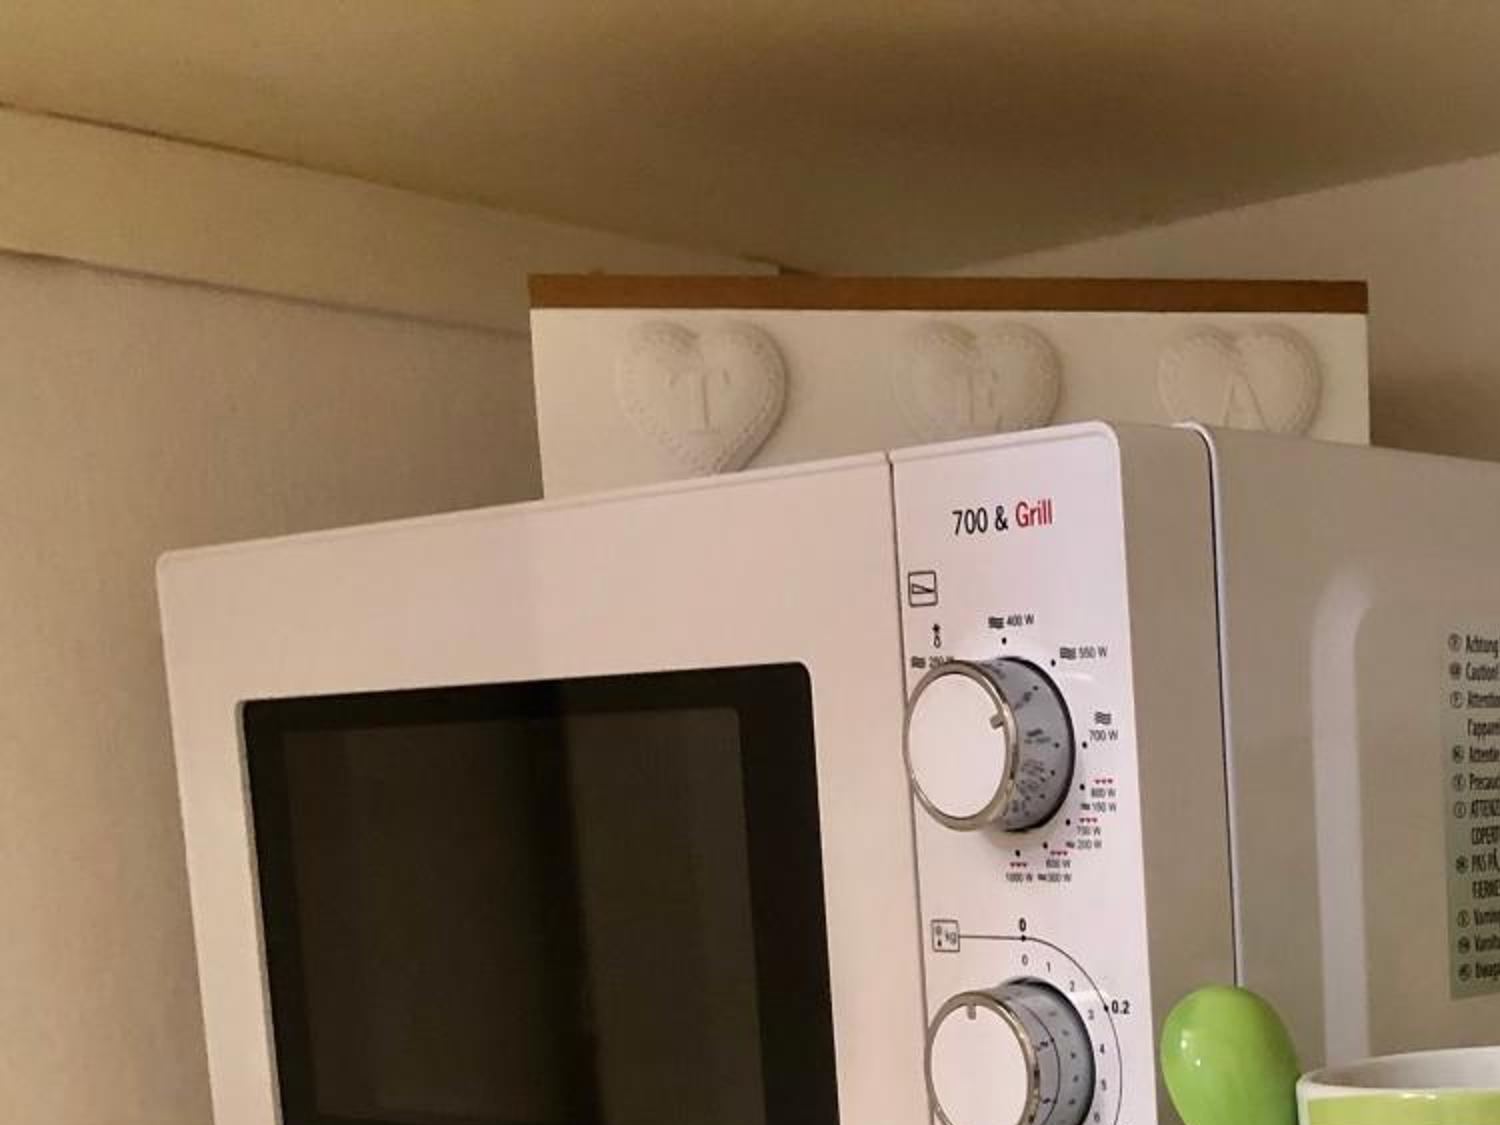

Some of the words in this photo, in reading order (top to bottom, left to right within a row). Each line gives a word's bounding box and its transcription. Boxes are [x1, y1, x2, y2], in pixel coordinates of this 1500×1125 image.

[952, 507, 988, 535] 700
[995, 506, 1008, 531] &
[1015, 499, 1053, 527] Grill
[1007, 615, 1022, 627] 400
[1025, 614, 1034, 625] W
[1098, 646, 1108, 657] W
[1089, 730, 1106, 742] 700
[1108, 729, 1118, 741] W
[1018, 918, 1027, 932] 0
[1111, 1000, 1130, 1014] 0.2
